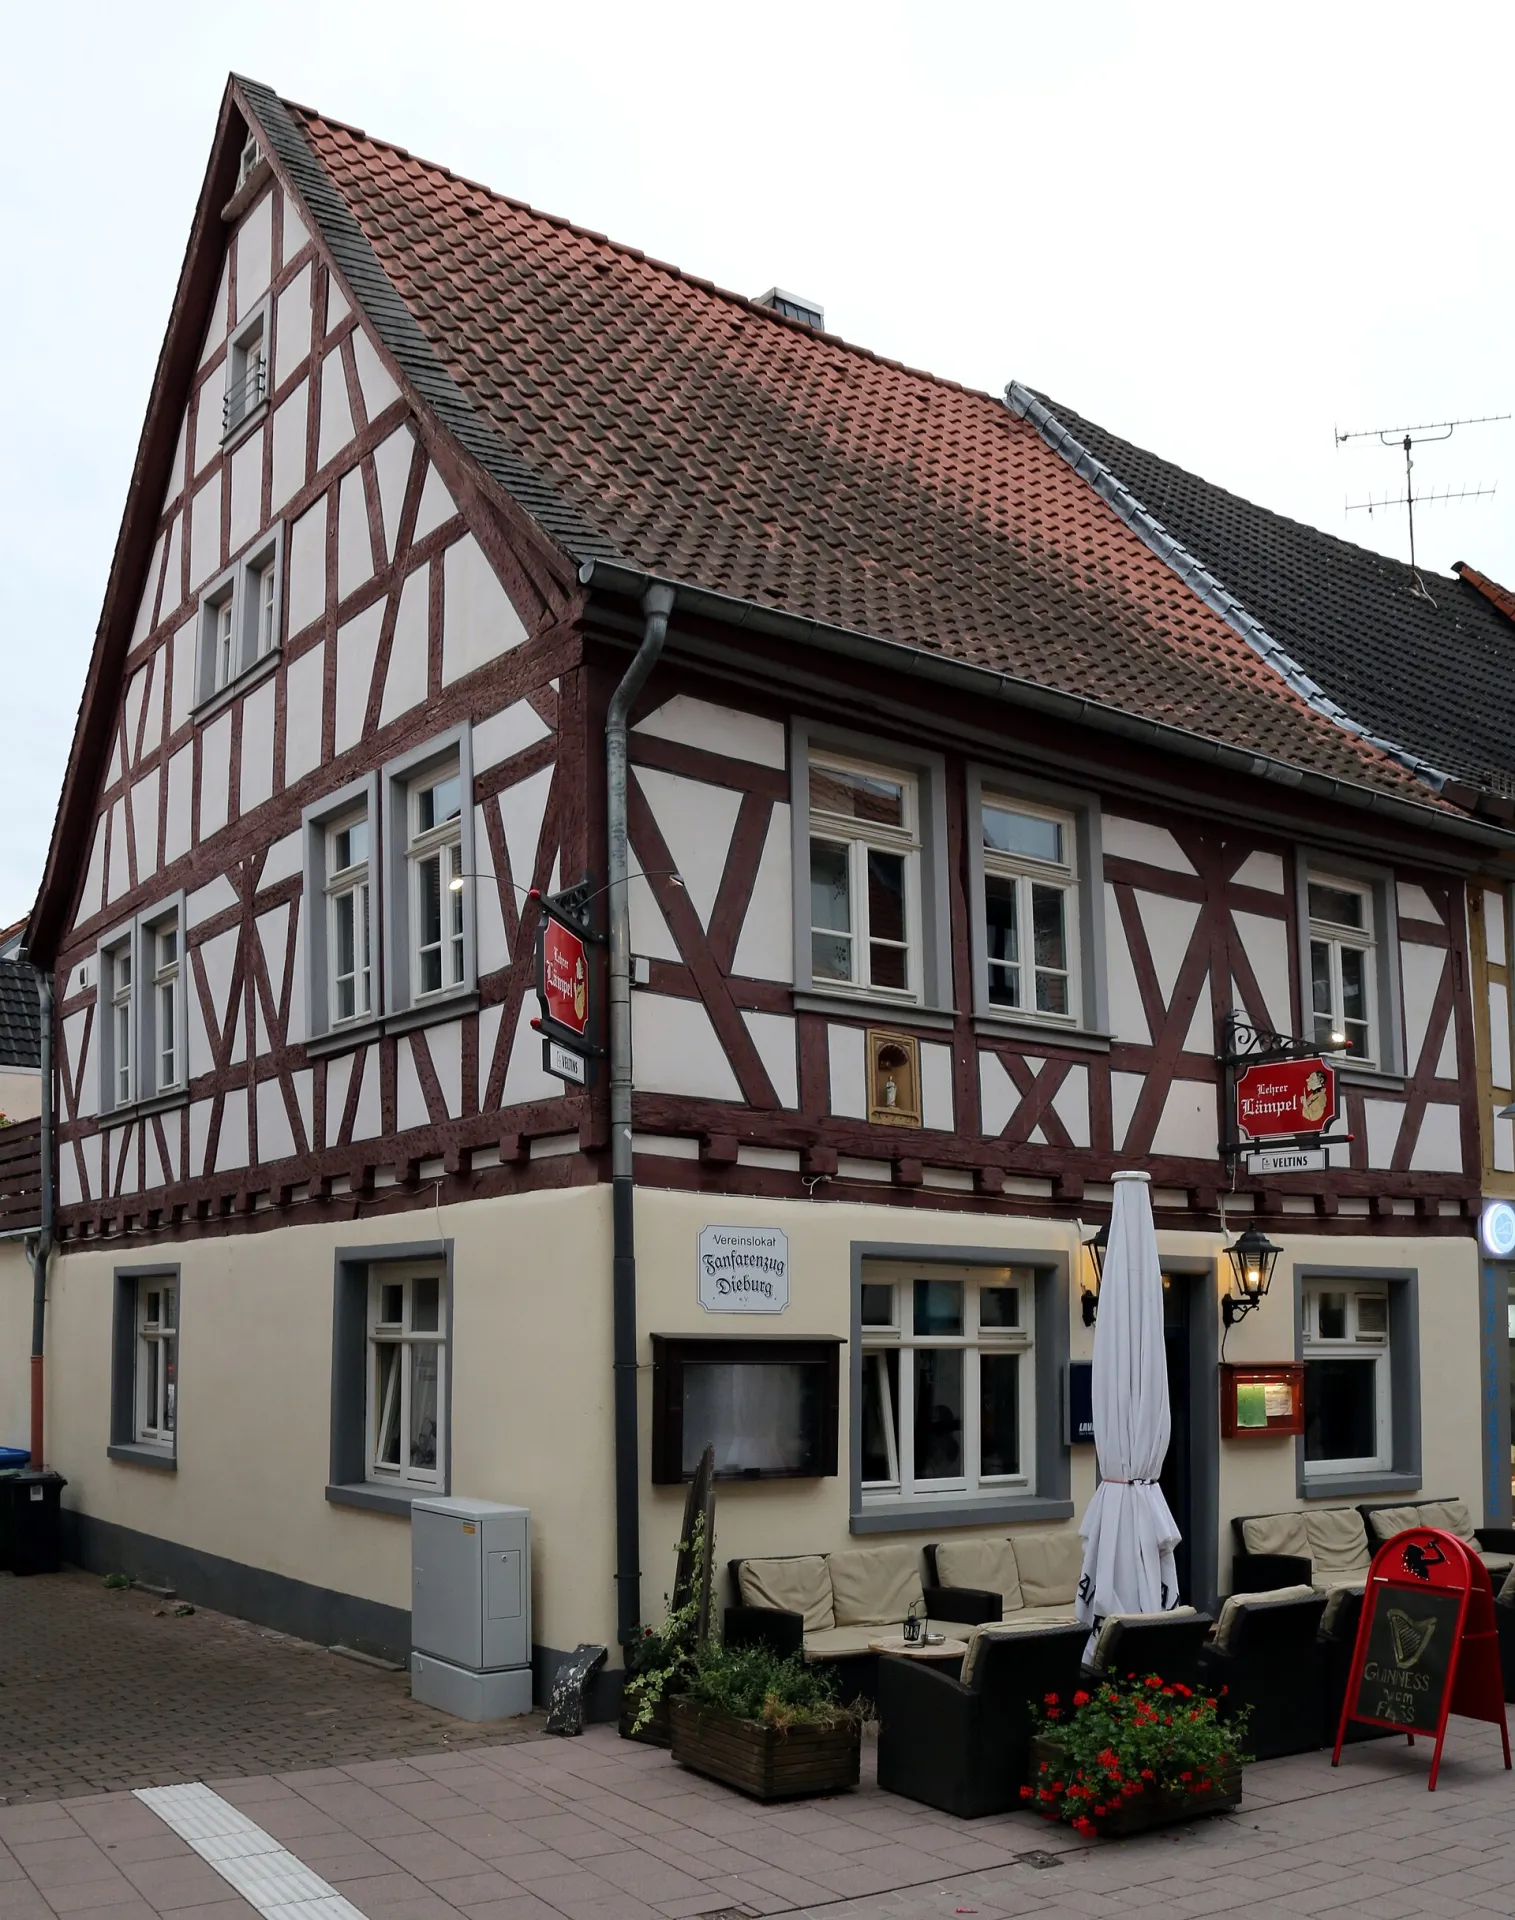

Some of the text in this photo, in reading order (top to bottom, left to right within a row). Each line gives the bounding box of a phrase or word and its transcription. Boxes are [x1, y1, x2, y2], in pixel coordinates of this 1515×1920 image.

[553, 946, 569, 970] Lehrer
[546, 959, 573, 1000] Lämpel
[561, 1054, 578, 1074] VELTINS
[1256, 1083, 1289, 1097] Lehrer
[1240, 1094, 1297, 1120] Lämpel
[1272, 1156, 1308, 1168] VELTINS
[713, 1234, 776, 1247] Vereinslokal
[702, 1249, 786, 1277] Fanfarenzug
[715, 1274, 774, 1298] Dieburg
[1363, 1662, 1430, 1692] GUINNESS
